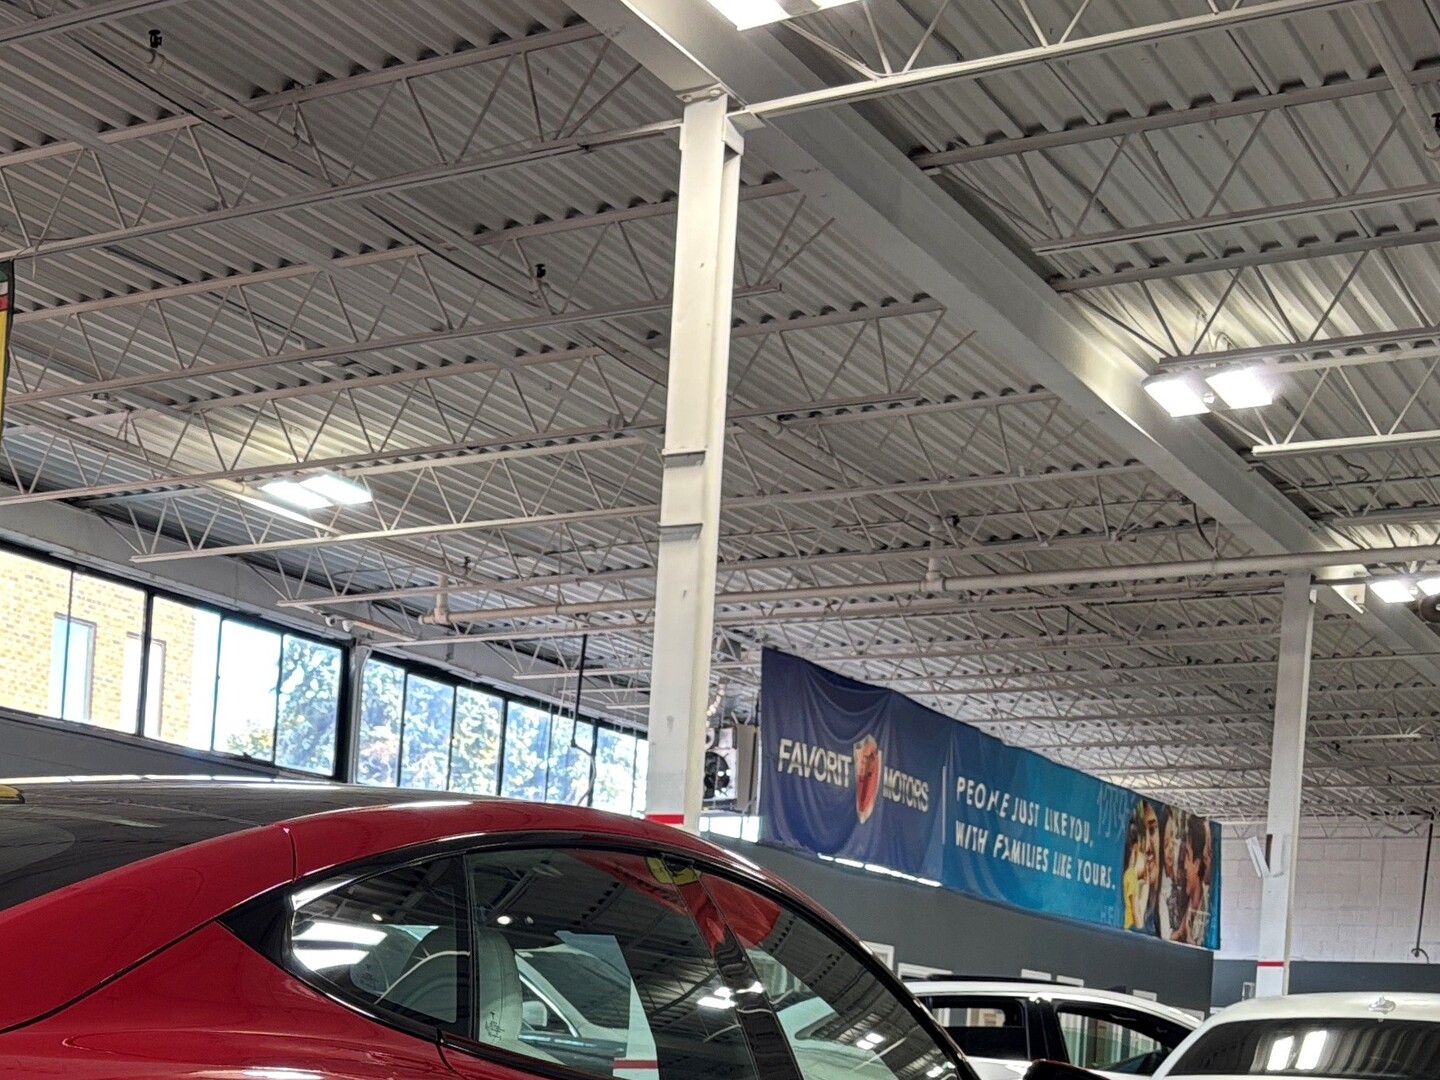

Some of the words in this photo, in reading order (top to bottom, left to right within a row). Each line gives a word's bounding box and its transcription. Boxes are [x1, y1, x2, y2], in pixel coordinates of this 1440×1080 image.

[777, 737, 853, 788] FAVORIT
[882, 765, 930, 813] MOTORS
[955, 820, 989, 855] WITH
[993, 833, 1049, 873] FAMILIES
[1052, 851, 1072, 880] LIKE
[1077, 859, 1116, 891] YOURS.
[1011, 797, 1040, 828] JUST
[1044, 807, 1068, 837] LIKE
[1069, 815, 1094, 848] YOU,
